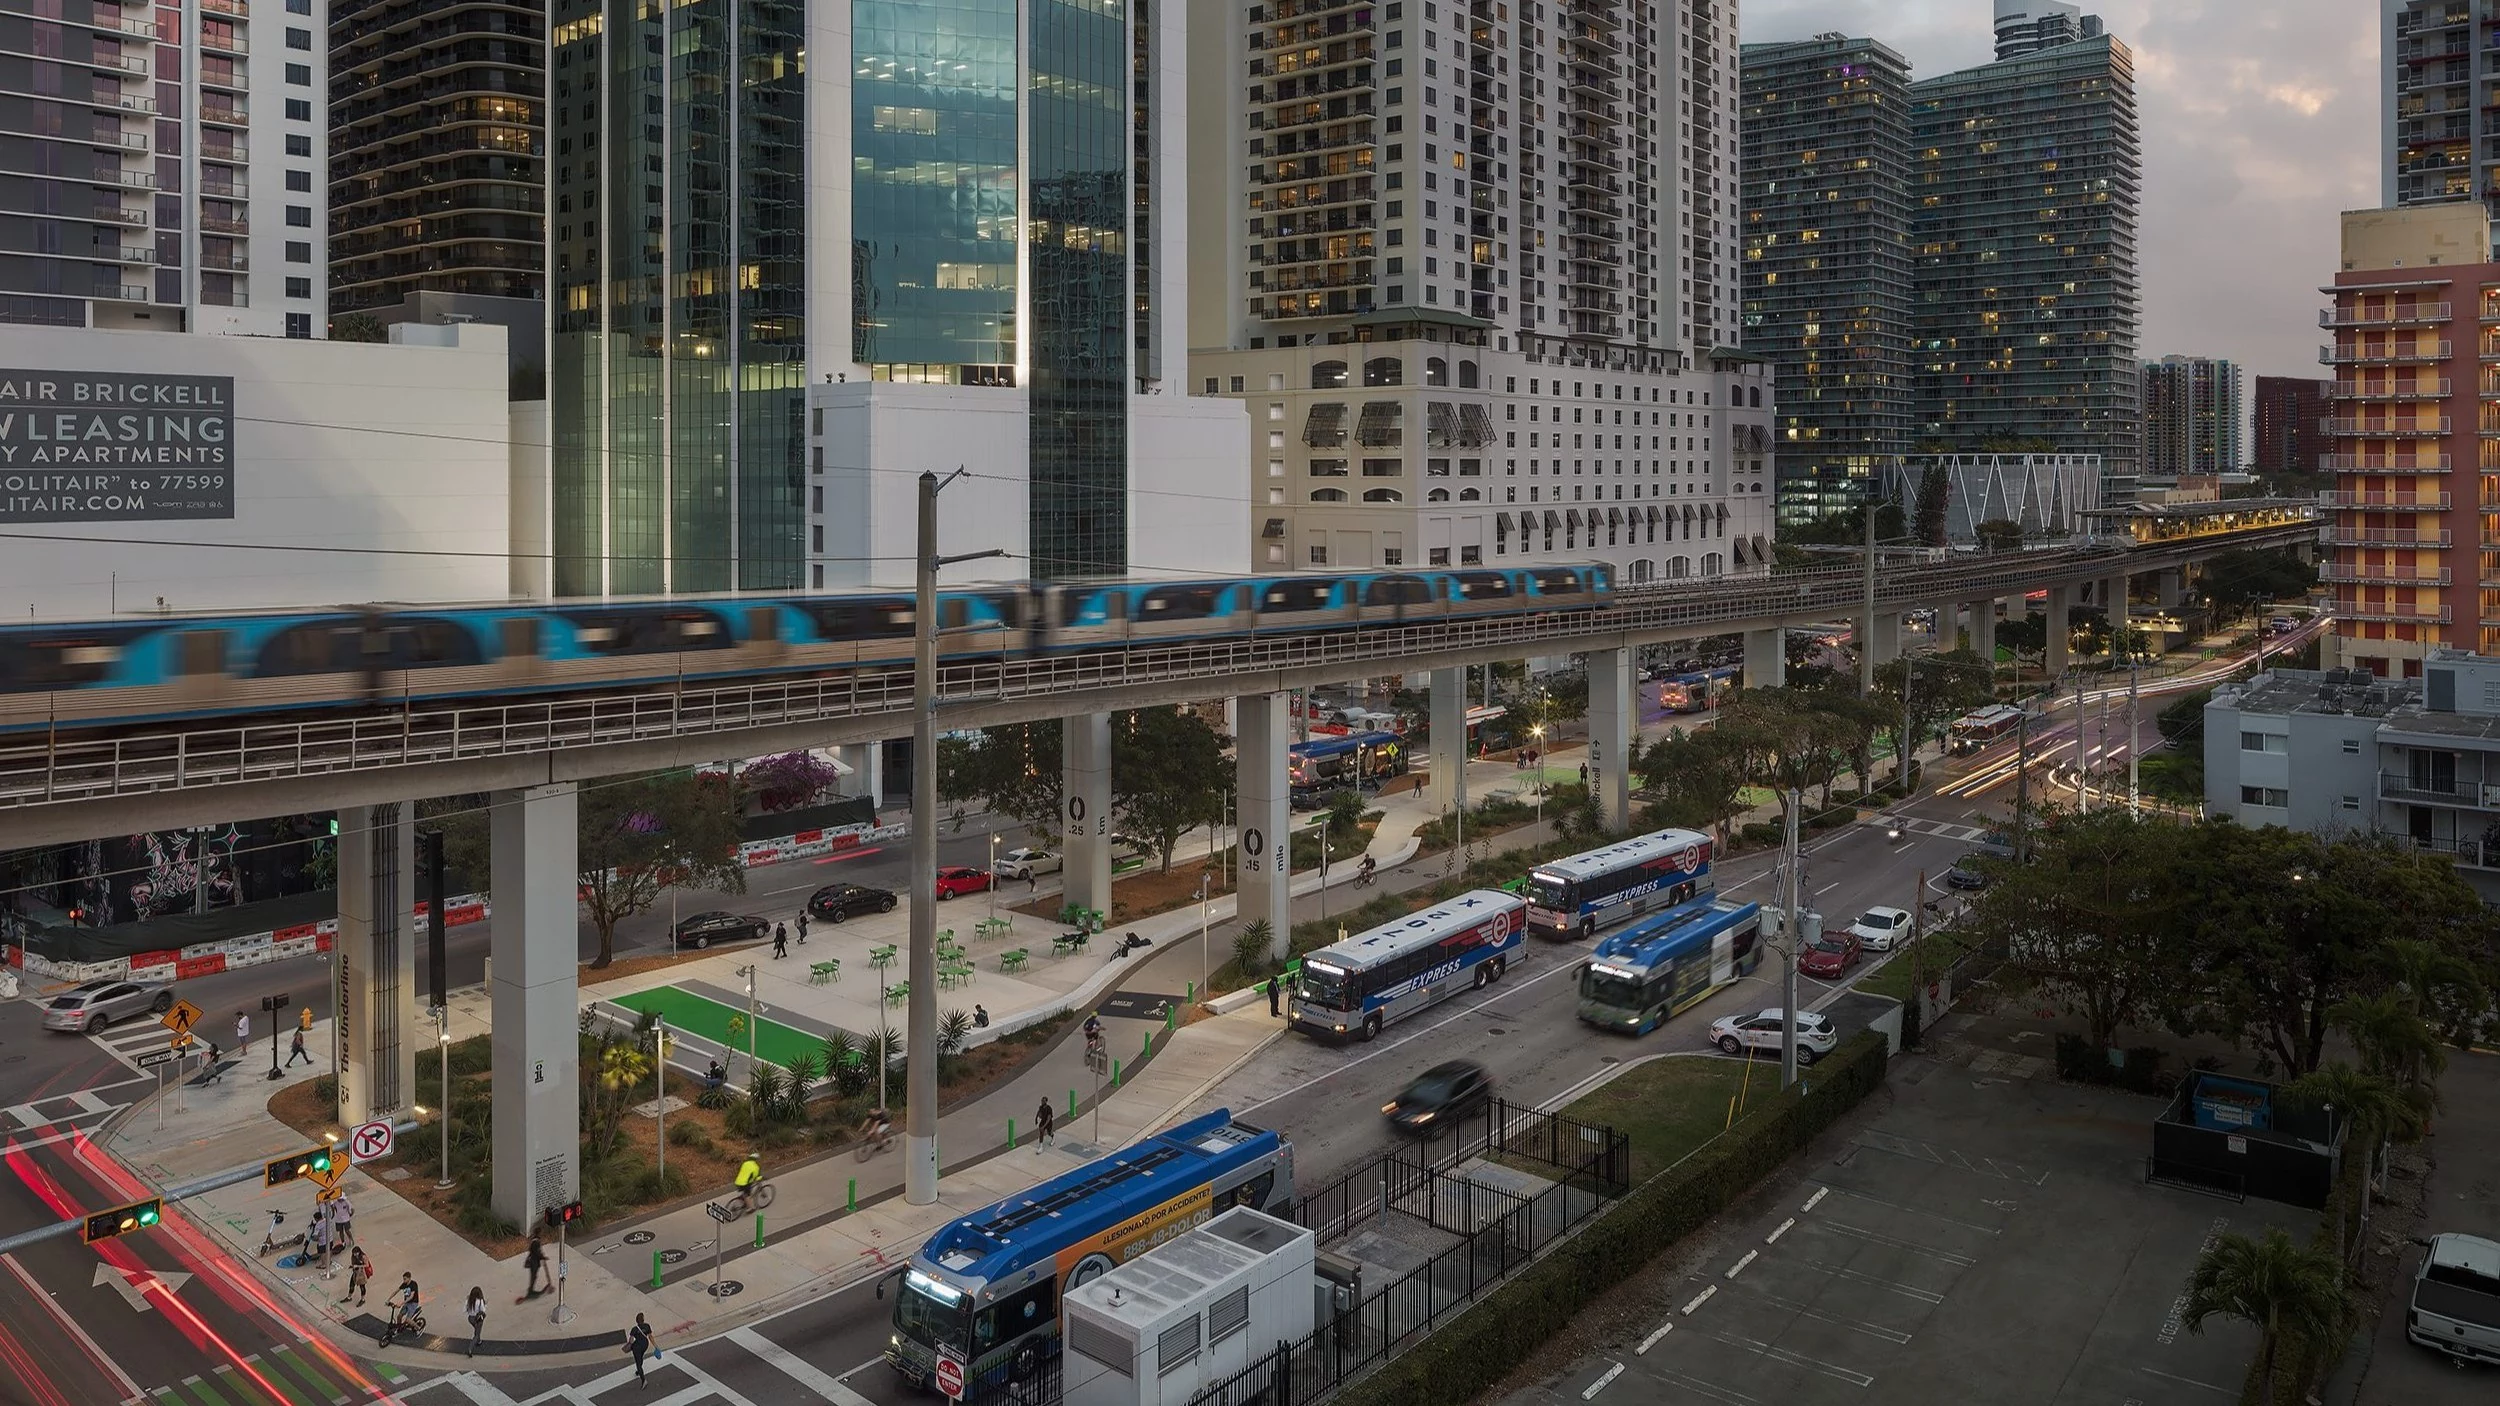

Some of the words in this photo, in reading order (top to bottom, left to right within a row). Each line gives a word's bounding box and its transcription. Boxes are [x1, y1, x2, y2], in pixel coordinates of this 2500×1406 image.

[73, 382, 224, 404] BRICKELL
[28, 413, 225, 442] LEASING
[31, 446, 225, 463] APARTMENTS
[0, 475, 121, 491] OLITAIR”
[130, 478, 151, 490] to
[159, 475, 225, 490] 77599
[1069, 796, 1085, 821] 0
[1068, 824, 1084, 836] .25
[1097, 815, 1105, 836] km
[1243, 828, 1263, 856] 0
[1245, 859, 1260, 871] .15
[1276, 844, 1284, 871] mile
[1616, 879, 1659, 903] EXPRESS
[1410, 957, 1462, 992] EXPRESS
[340, 953, 349, 1039] Underline
[341, 1043, 349, 1074] The
[1102, 1216, 1151, 1245] ¿LESIONADO
[1151, 1208, 1167, 1223] POR
[1167, 1187, 1211, 1215] ACCIDENTE?
[940, 1363, 948, 1371] DO
[949, 1367, 959, 1376] NOT
[941, 1379, 957, 1391] ENTER
